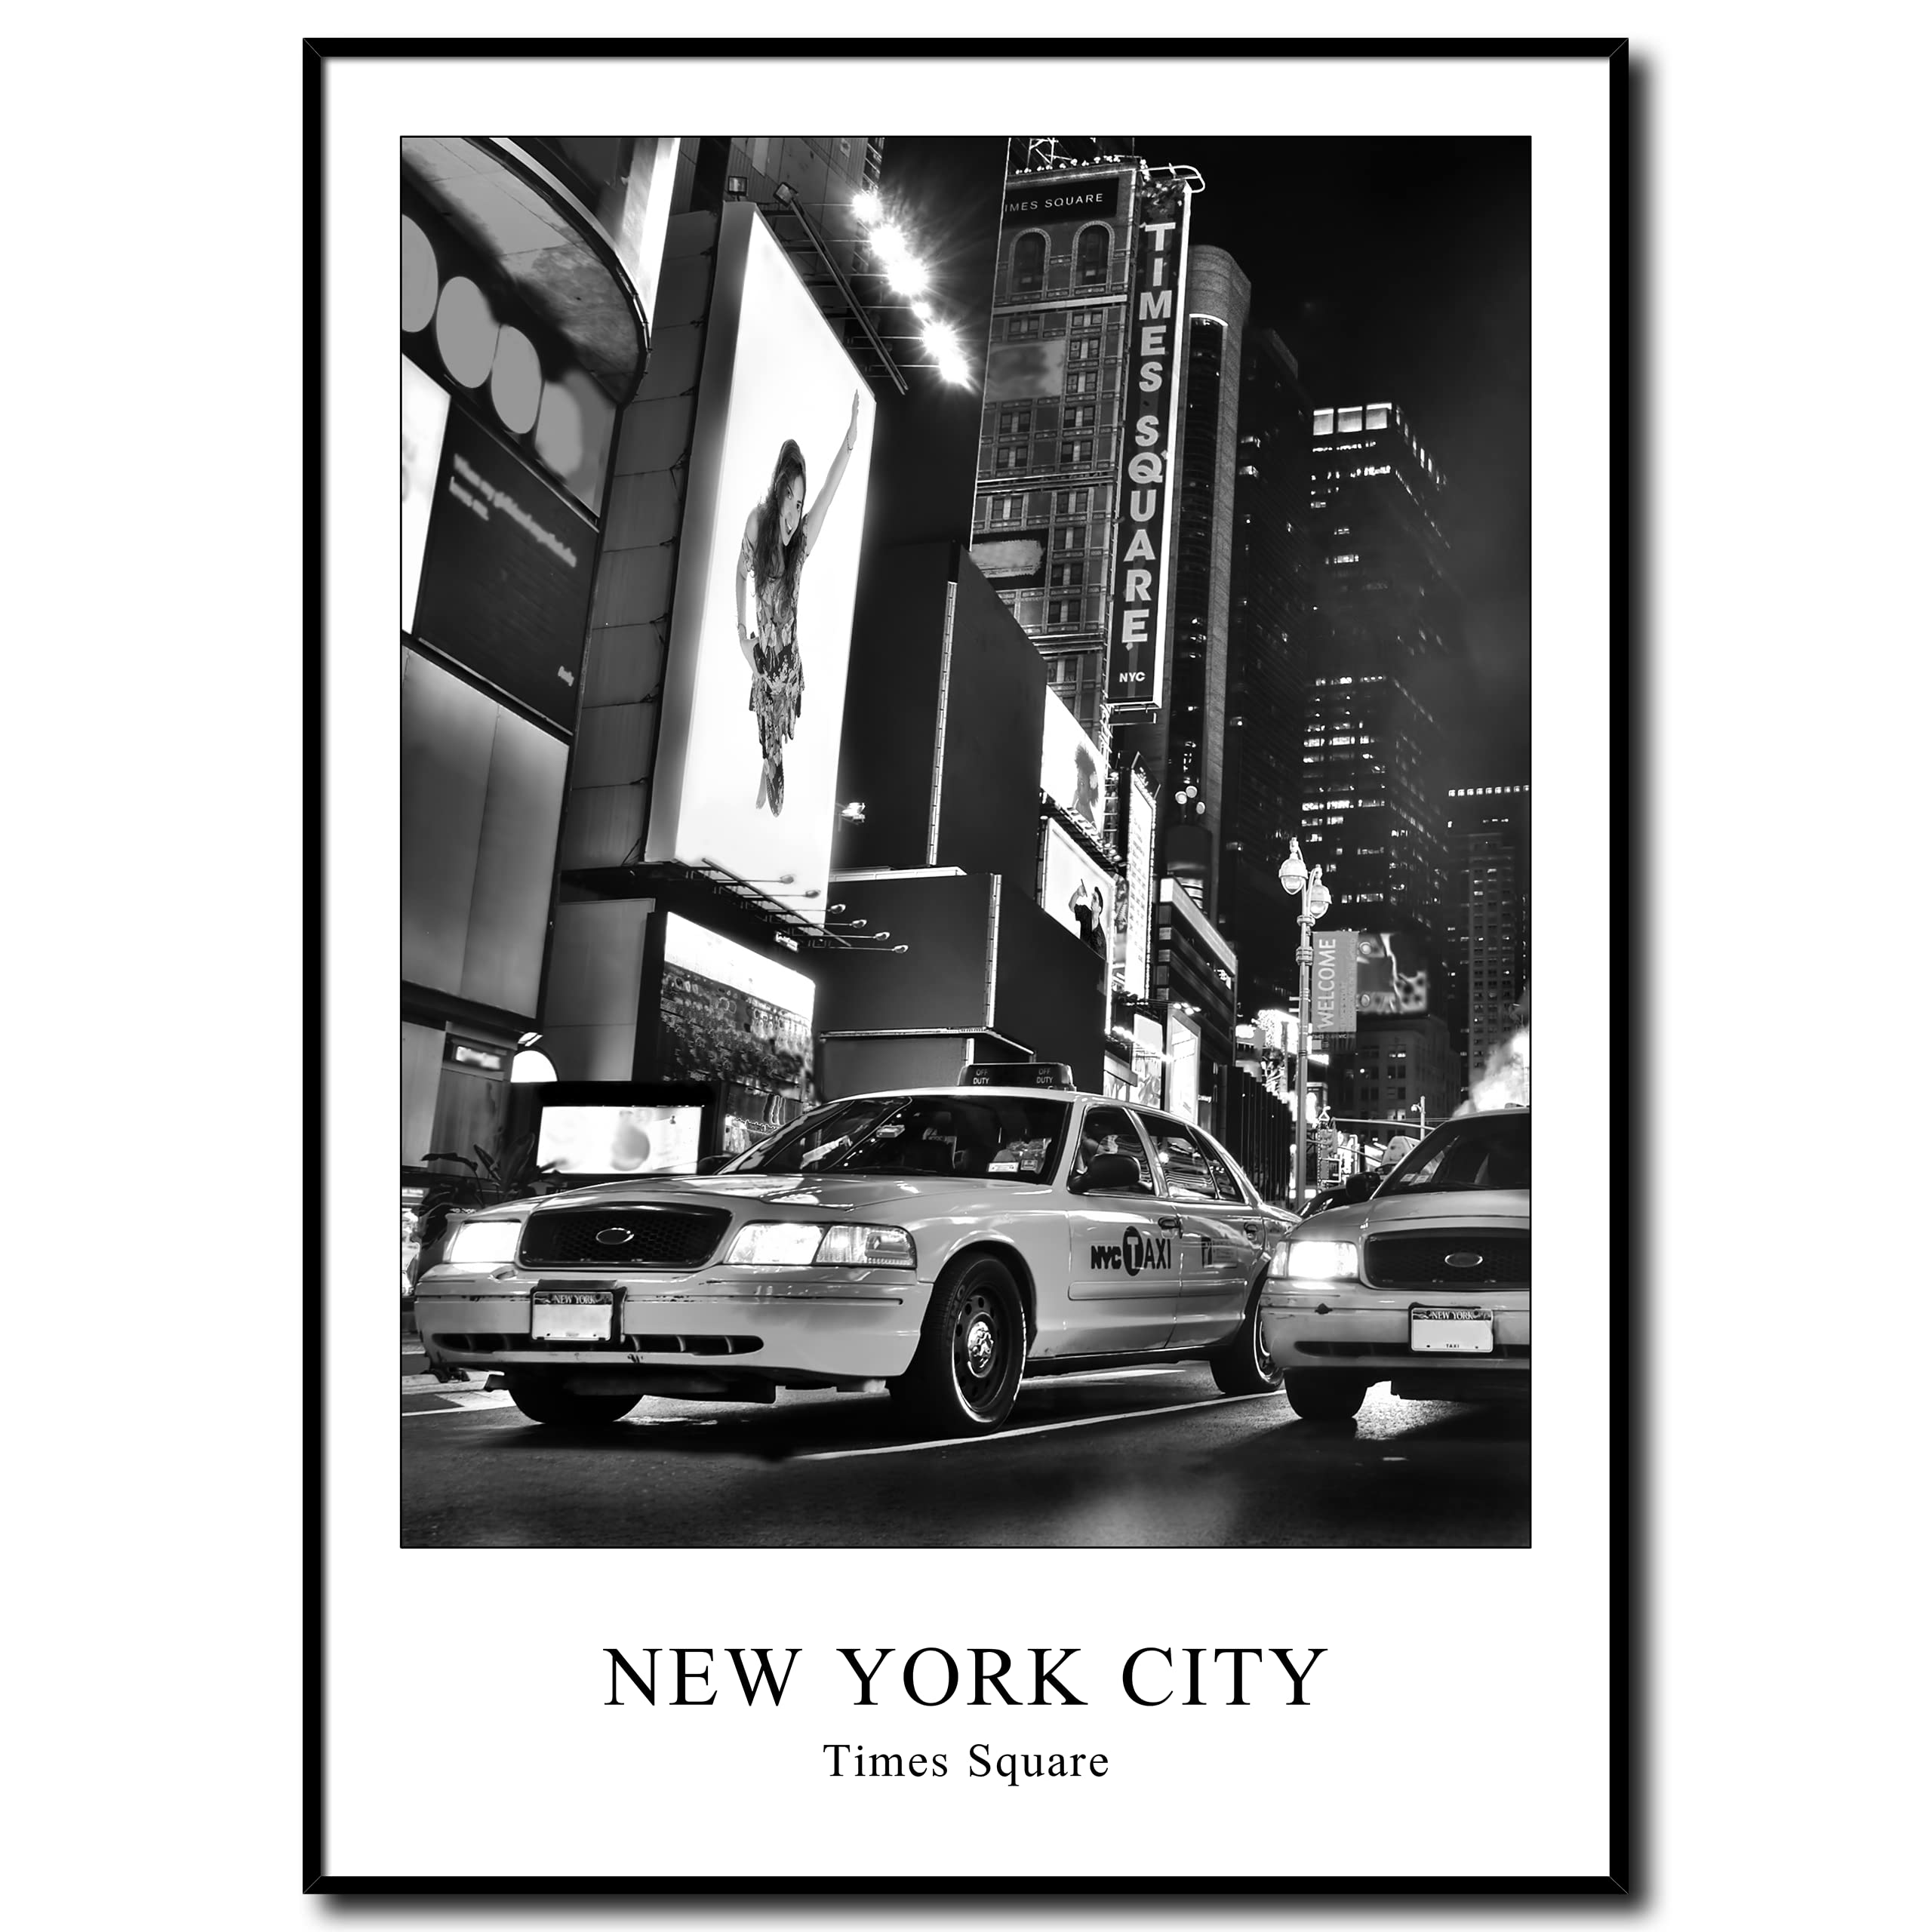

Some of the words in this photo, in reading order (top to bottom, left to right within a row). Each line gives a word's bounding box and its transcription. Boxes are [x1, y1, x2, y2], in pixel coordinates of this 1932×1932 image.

[1004, 201, 1038, 212] IMES
[1044, 193, 1103, 208] SQUARE
[1138, 222, 1176, 392] TIMES
[1121, 414, 1163, 644] SQUARE
[1119, 671, 1146, 683] NYC
[1317, 938, 1337, 1030] WELCOME
[973, 1077, 990, 1085] DUTY
[1091, 1245, 1122, 1270] NYC
[1124, 1232, 1171, 1272] TAXI
[555, 1294, 573, 1304] NEW
[574, 1294, 596, 1304] YORK
[1432, 1311, 1450, 1320] NEW
[1451, 1311, 1473, 1320] YORK
[603, 1649, 802, 1706] NEW
[836, 1647, 1088, 1706] YORK
[1123, 1647, 1327, 1706] CITY
[823, 1745, 947, 1777] Times
[970, 1744, 1108, 1786] Square
